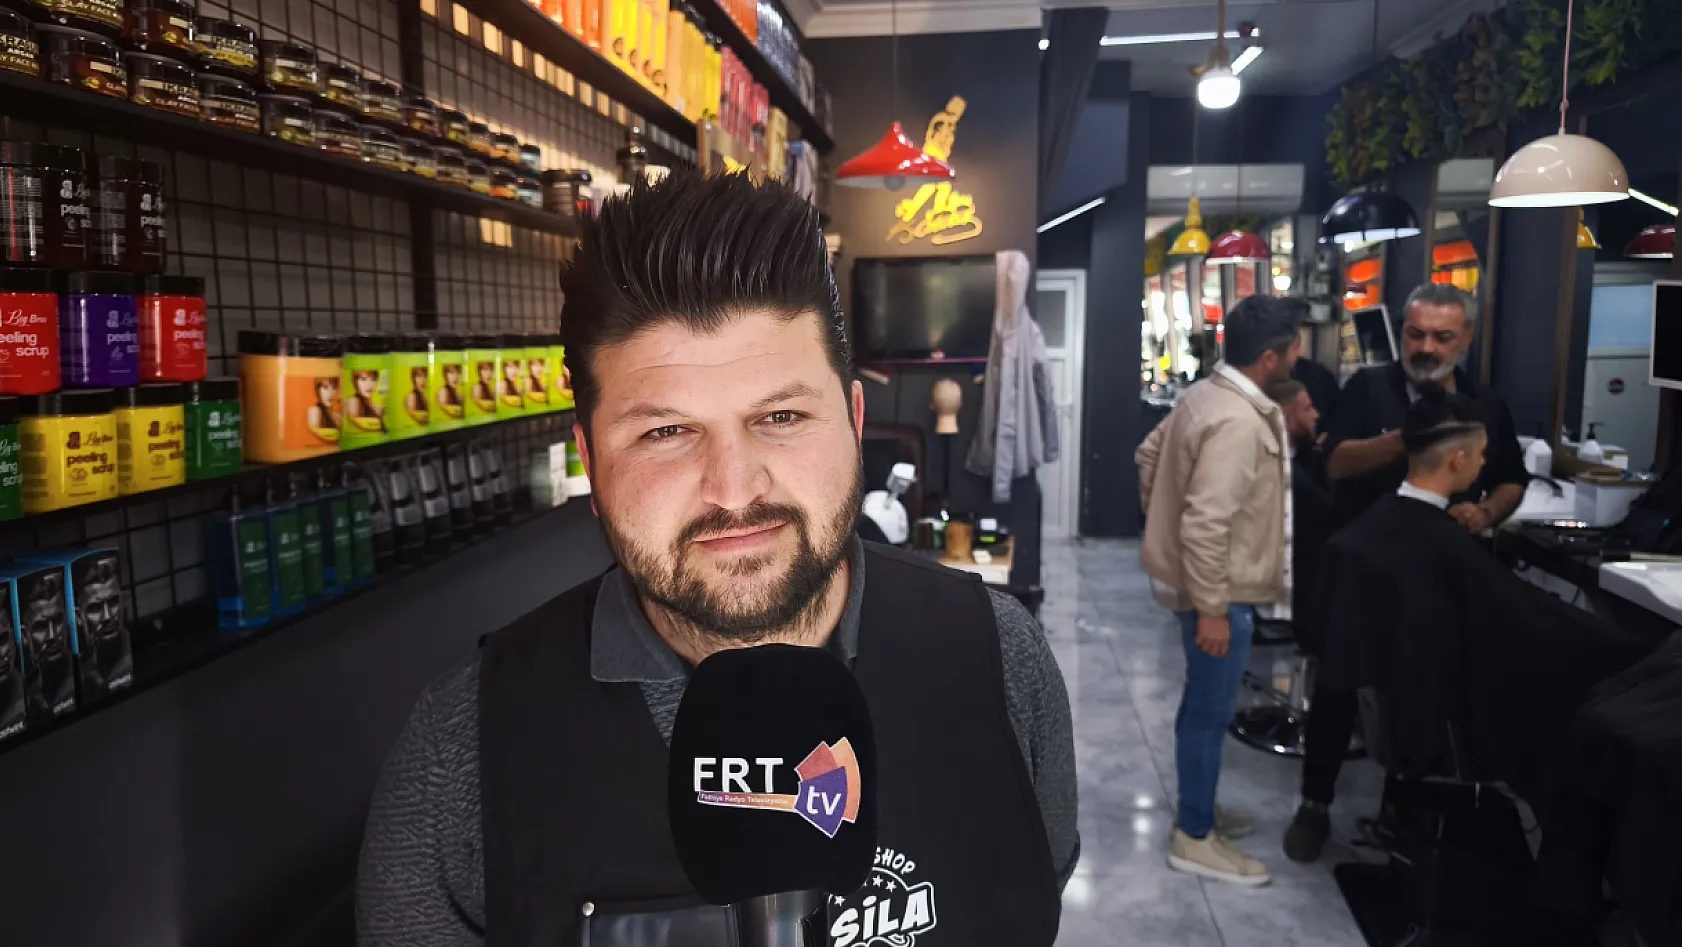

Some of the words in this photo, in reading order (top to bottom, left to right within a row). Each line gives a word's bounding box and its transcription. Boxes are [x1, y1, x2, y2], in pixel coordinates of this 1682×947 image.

[0, 331, 37, 346] eeling
[693, 757, 784, 793] FRT
[806, 785, 843, 816] tv
